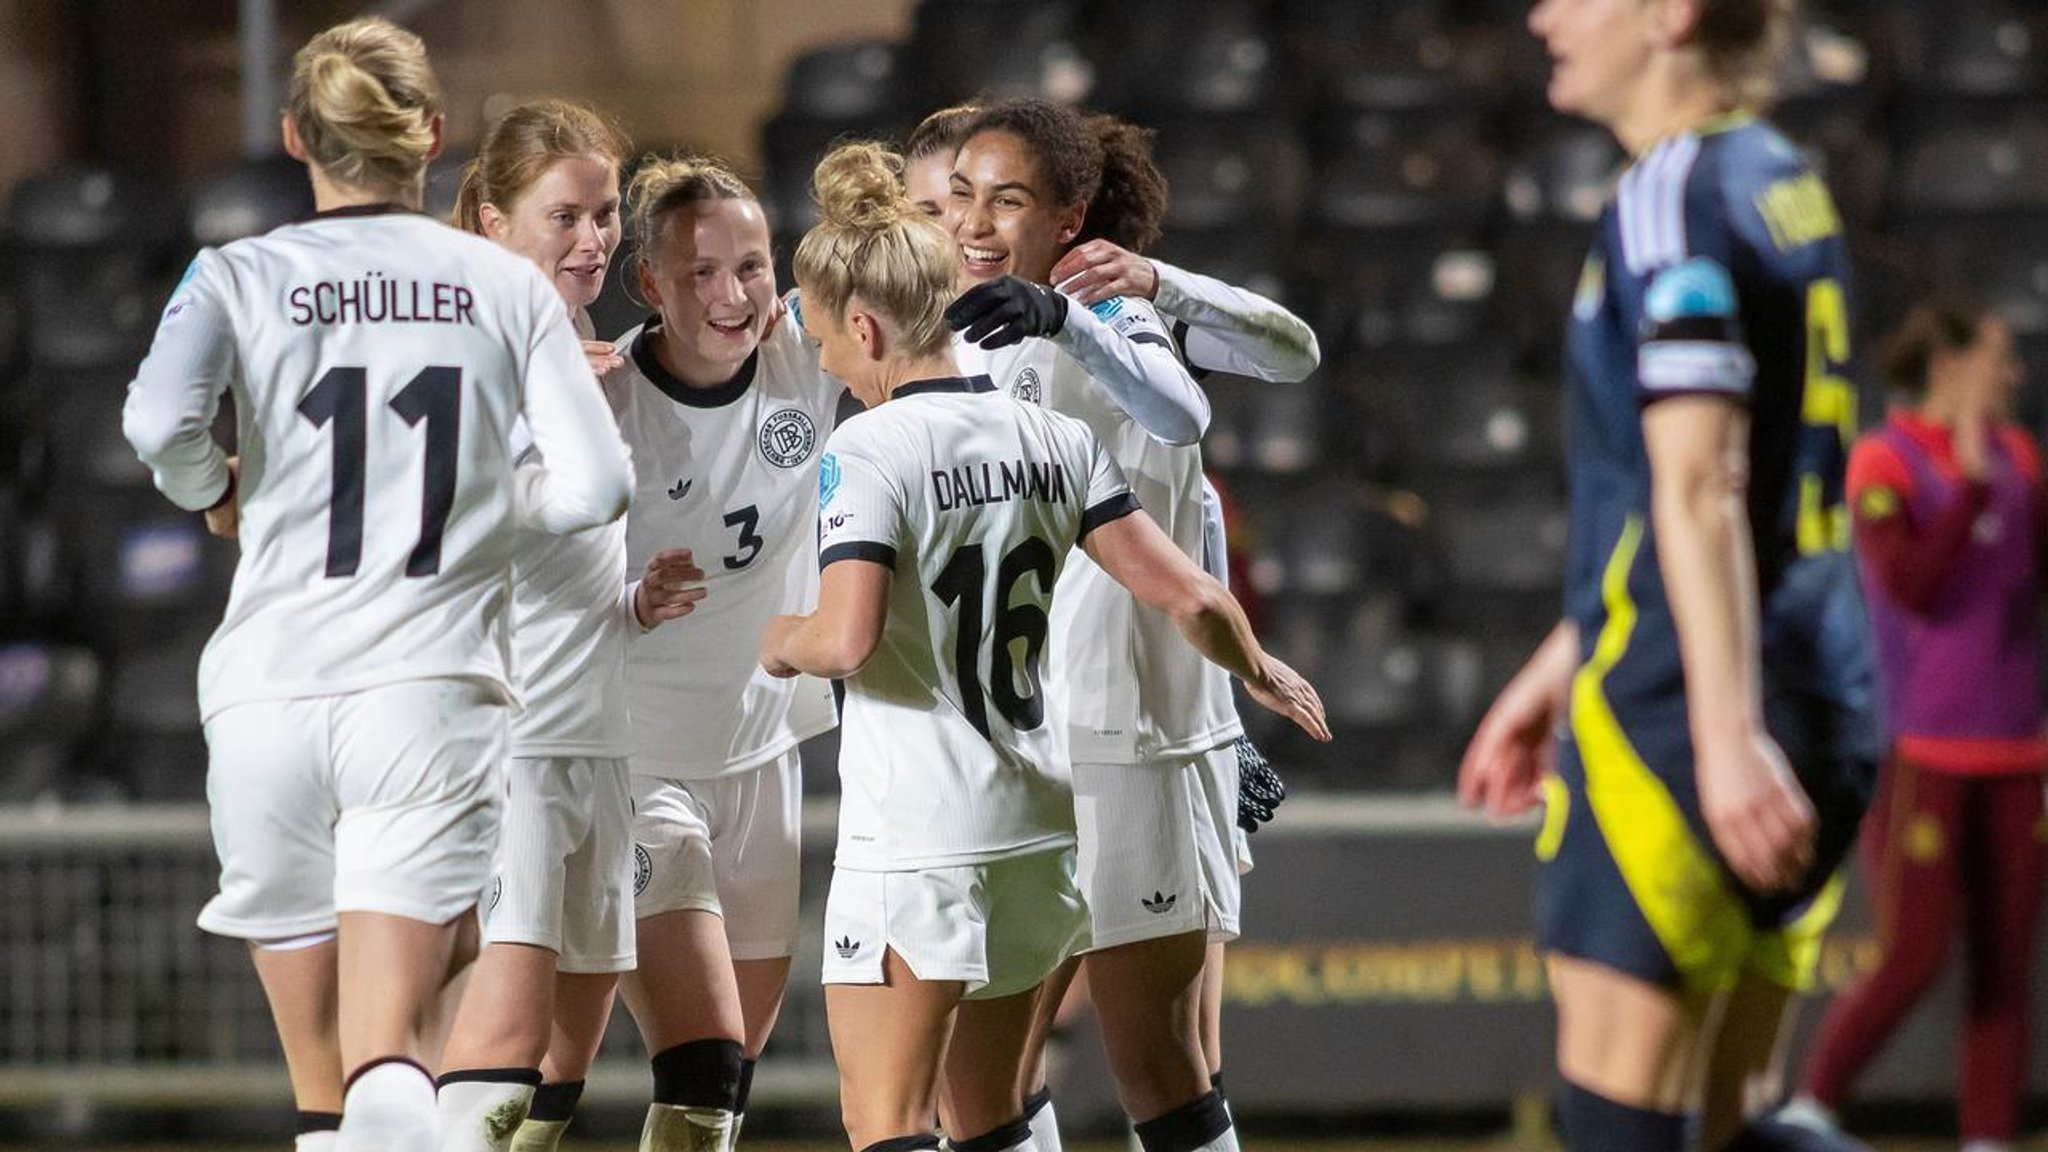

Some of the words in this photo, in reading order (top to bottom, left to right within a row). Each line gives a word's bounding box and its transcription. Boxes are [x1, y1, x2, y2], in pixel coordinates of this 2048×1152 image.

[290, 271, 475, 326] SCHÜLLER
[295, 365, 462, 579] 11
[931, 459, 1066, 511] DALLMANN
[722, 503, 764, 570] 3
[930, 535, 1056, 742] 16
